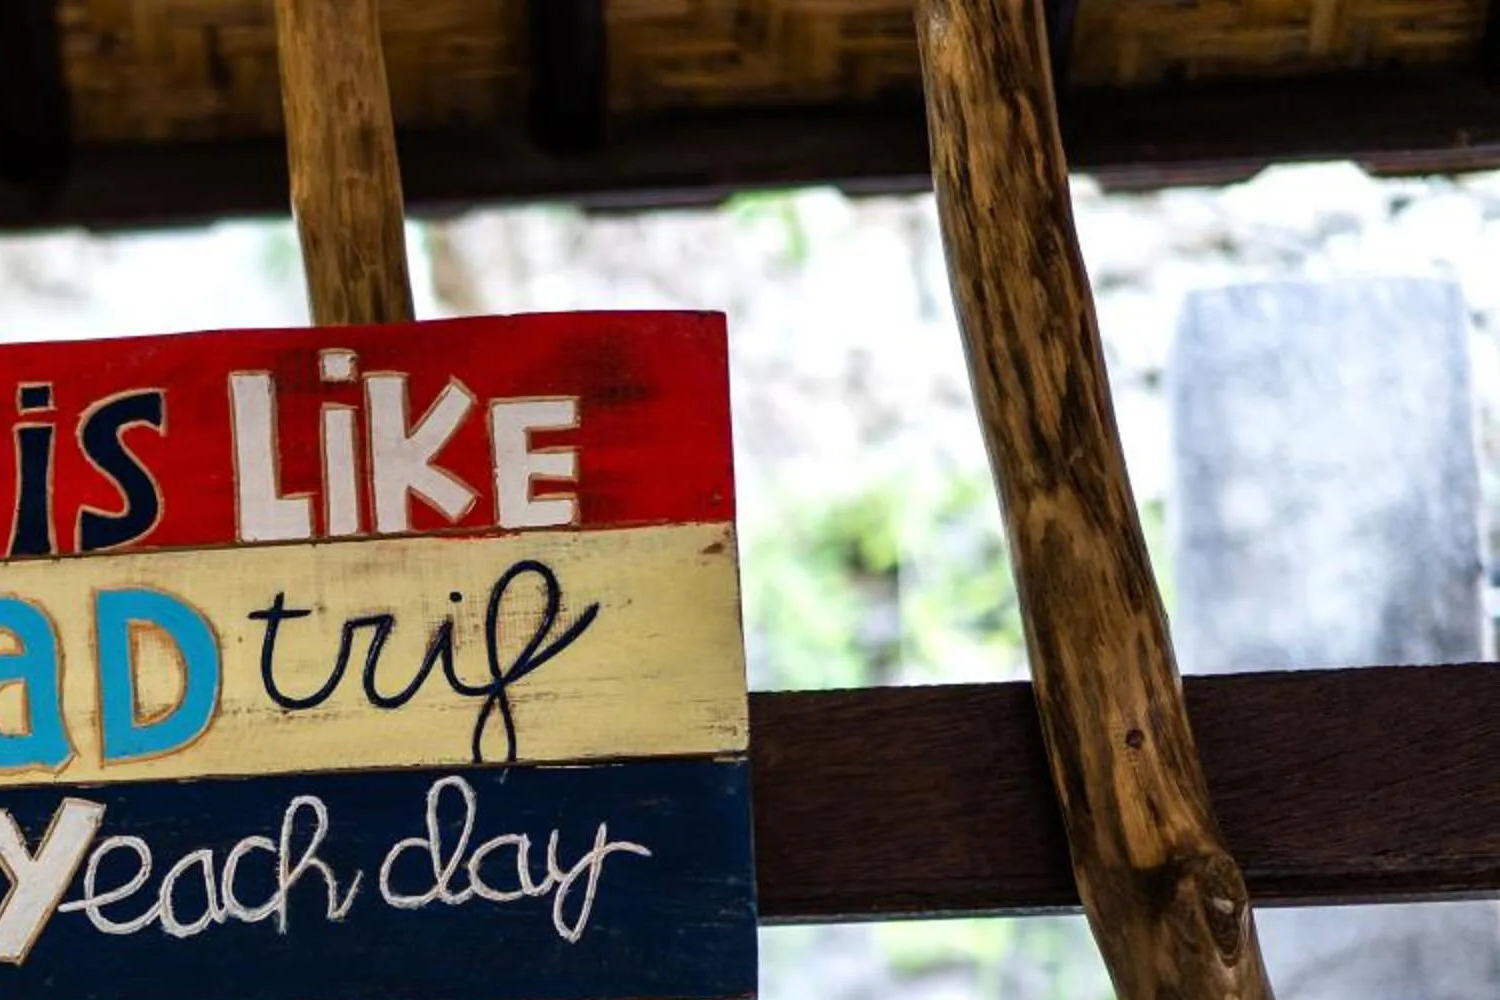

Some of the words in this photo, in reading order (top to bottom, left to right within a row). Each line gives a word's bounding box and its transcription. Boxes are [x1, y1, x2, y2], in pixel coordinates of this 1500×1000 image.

[5, 382, 168, 558] is
[249, 559, 601, 763] trip
[59, 795, 363, 938] each
[379, 775, 652, 943] day
